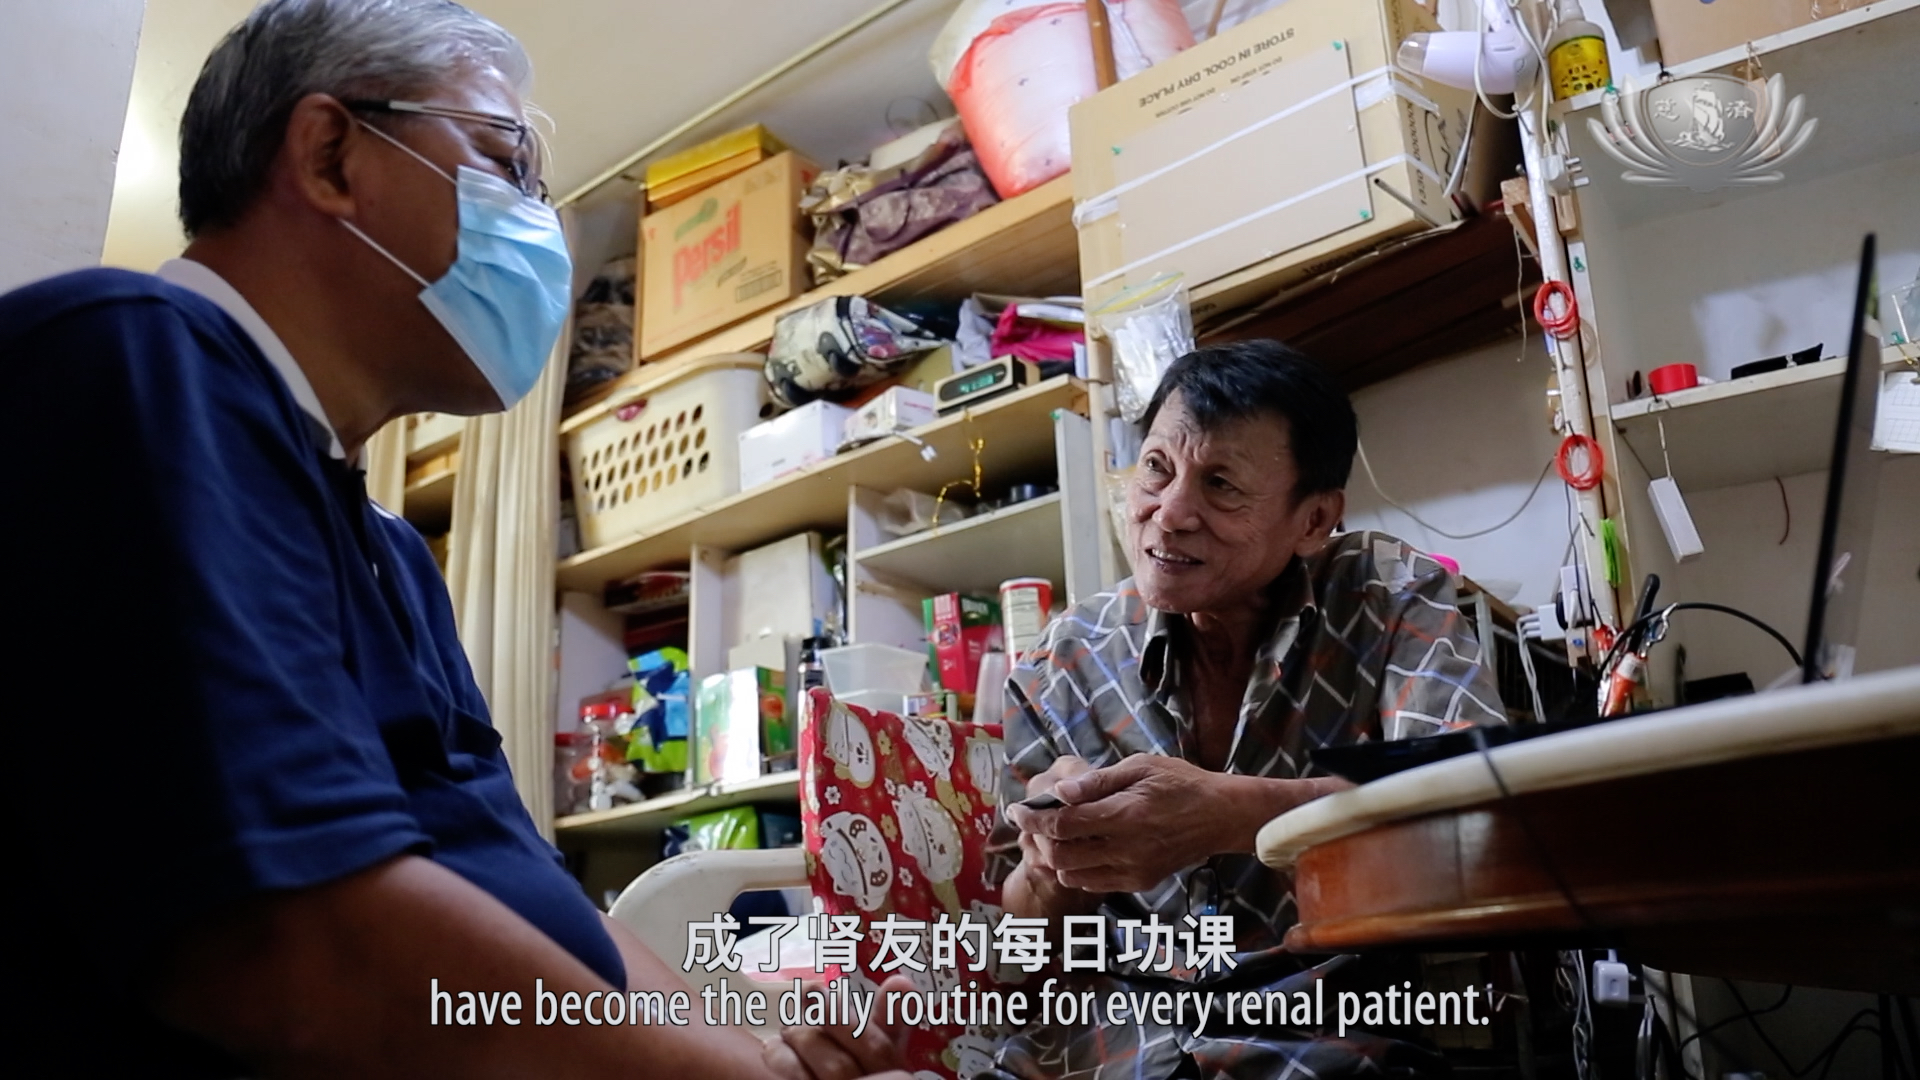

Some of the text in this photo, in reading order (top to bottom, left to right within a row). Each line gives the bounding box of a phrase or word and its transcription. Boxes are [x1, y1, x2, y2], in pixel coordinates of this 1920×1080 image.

[1139, 27, 1295, 108] STORE IN COOL DRY PLACE
[673, 199, 742, 309] Persil
